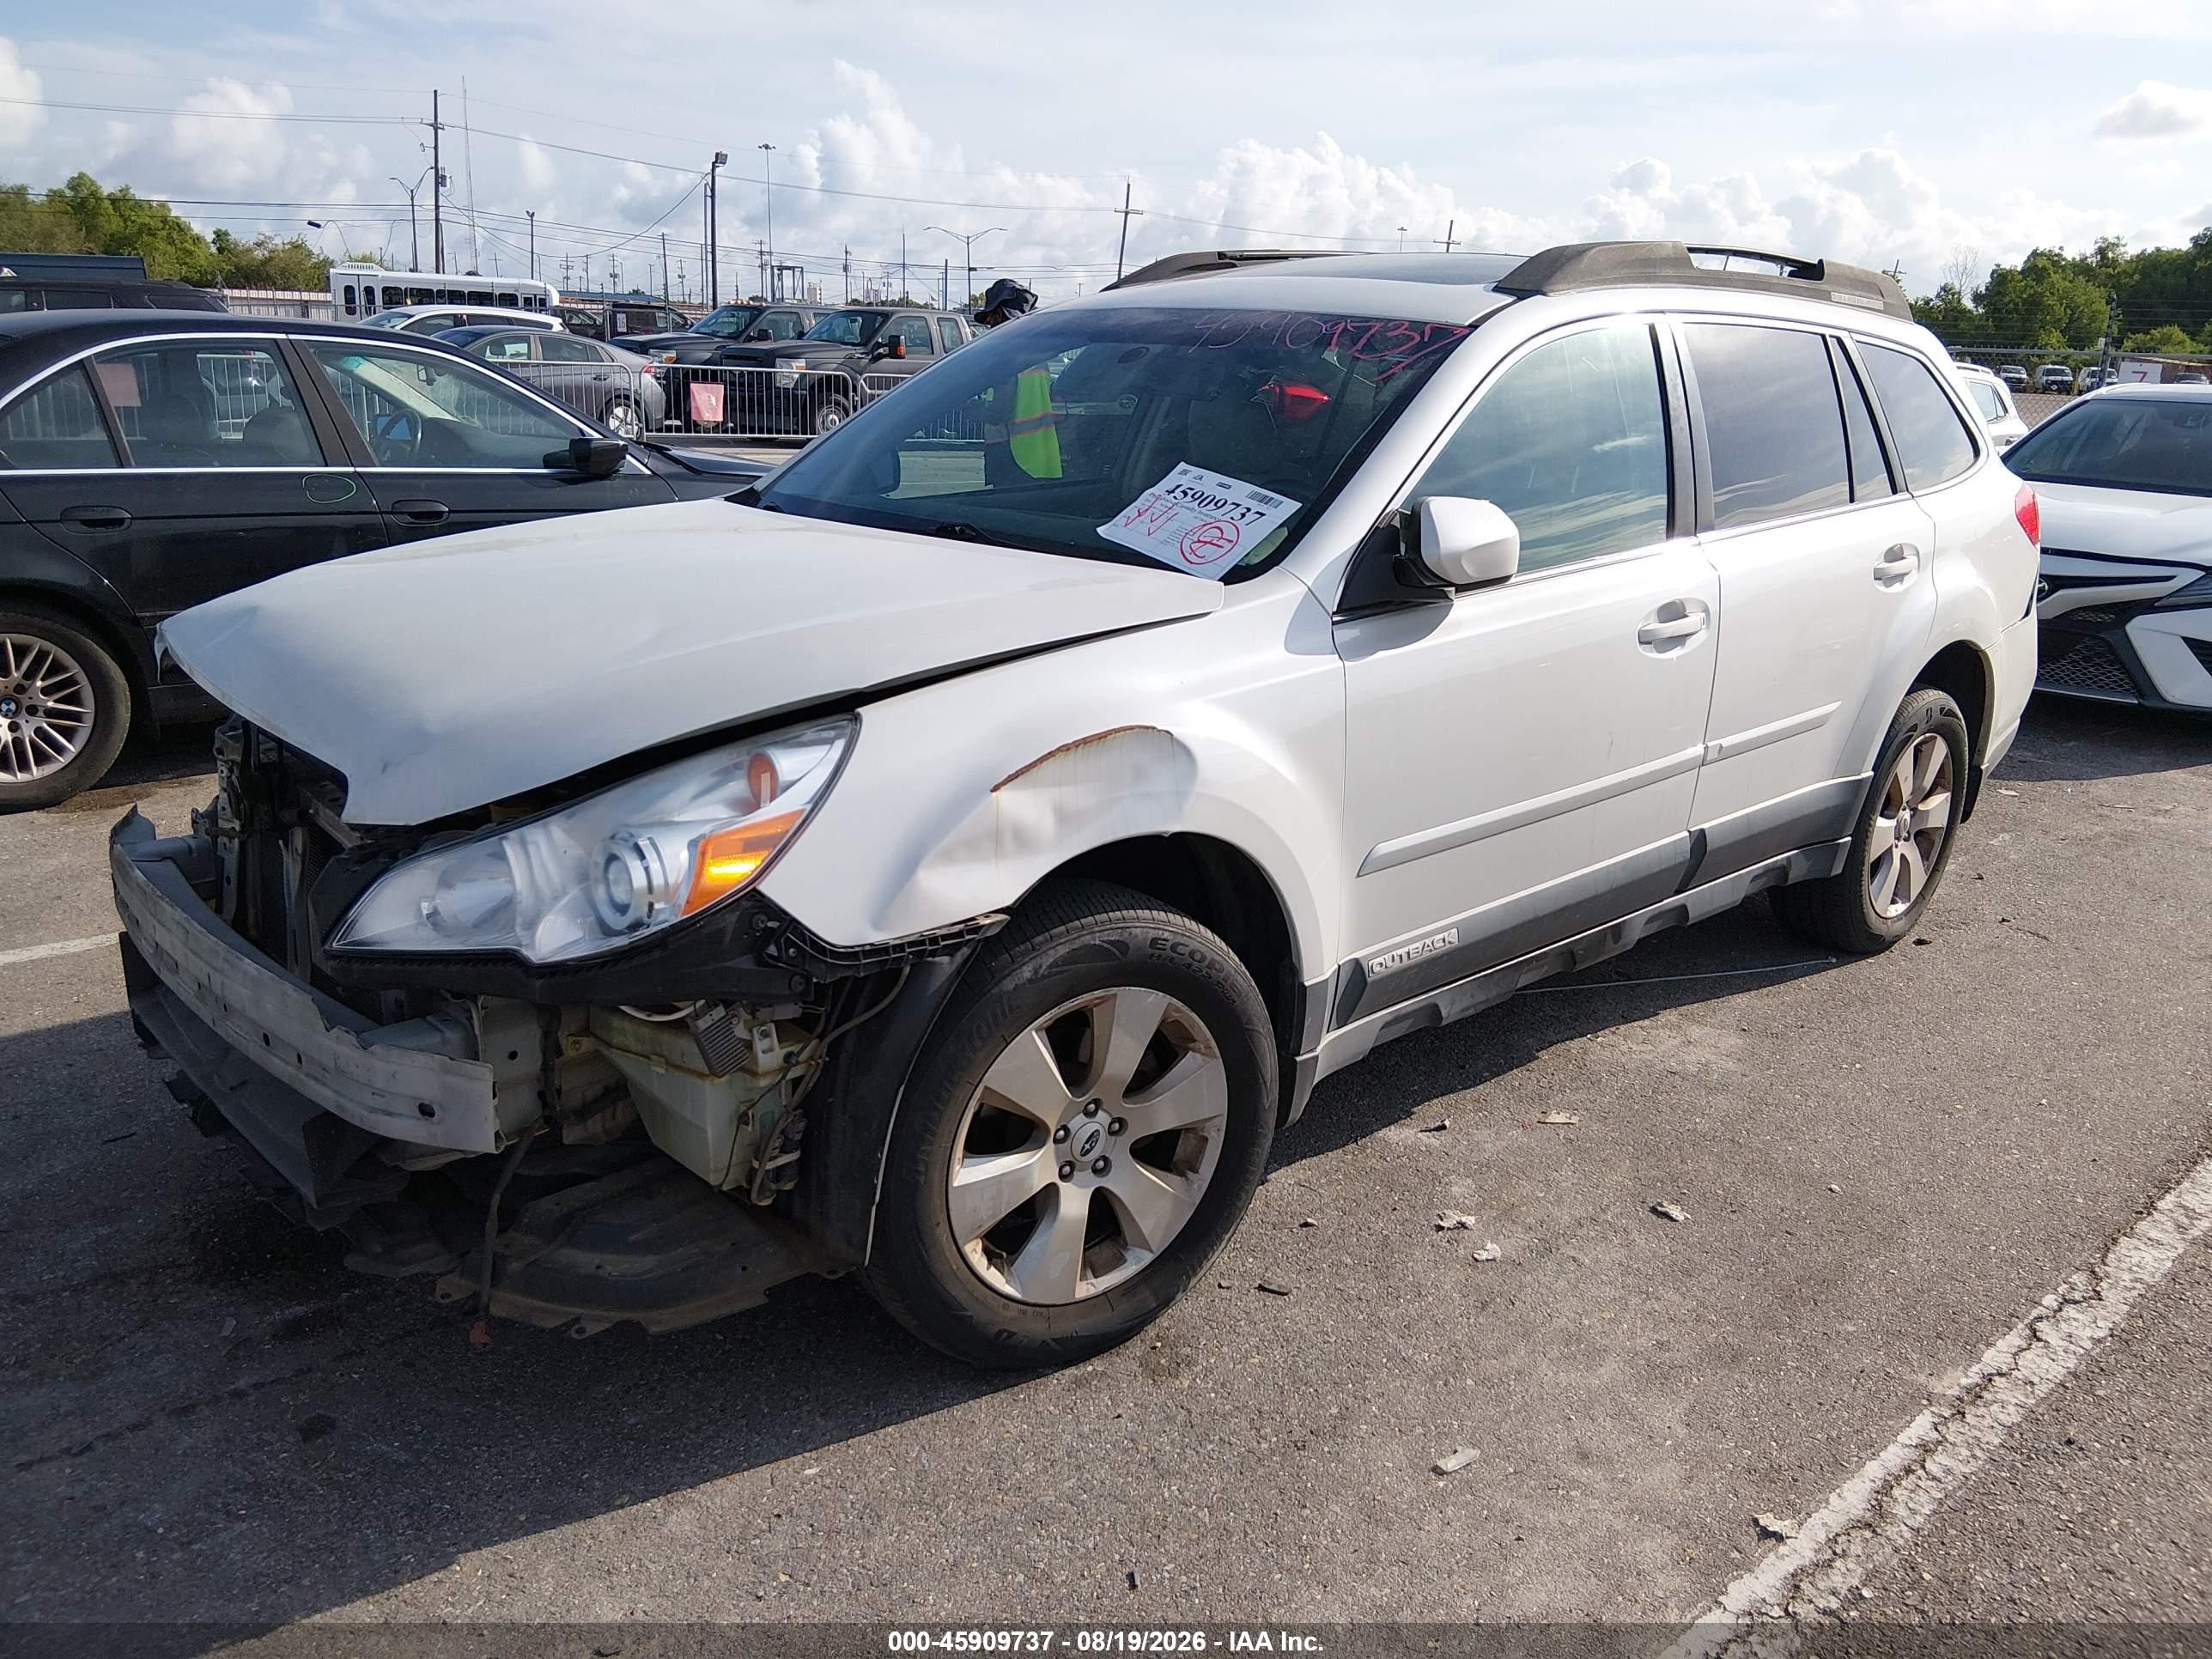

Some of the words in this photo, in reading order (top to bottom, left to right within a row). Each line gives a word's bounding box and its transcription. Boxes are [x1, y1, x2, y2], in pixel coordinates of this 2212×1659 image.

[617, 317, 626, 329] 16
[1164, 483, 1267, 525] 45909737
[1370, 930, 1457, 975] OUTBACK
